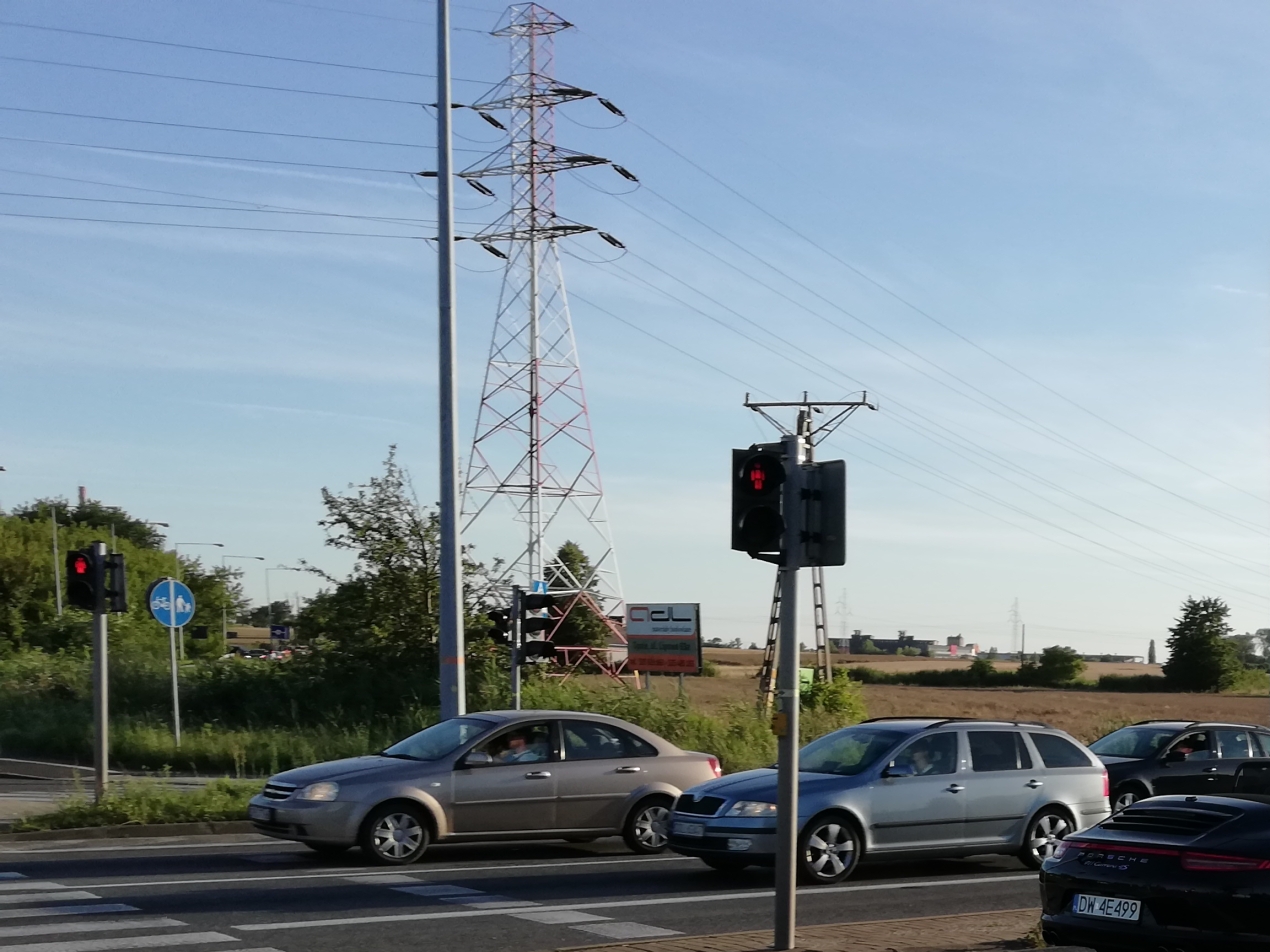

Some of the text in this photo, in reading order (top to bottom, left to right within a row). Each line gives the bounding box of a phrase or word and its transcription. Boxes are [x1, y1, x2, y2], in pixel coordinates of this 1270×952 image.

[1077, 852, 1149, 864] PORSCHE
[1079, 896, 1138, 919] DW 4E499
